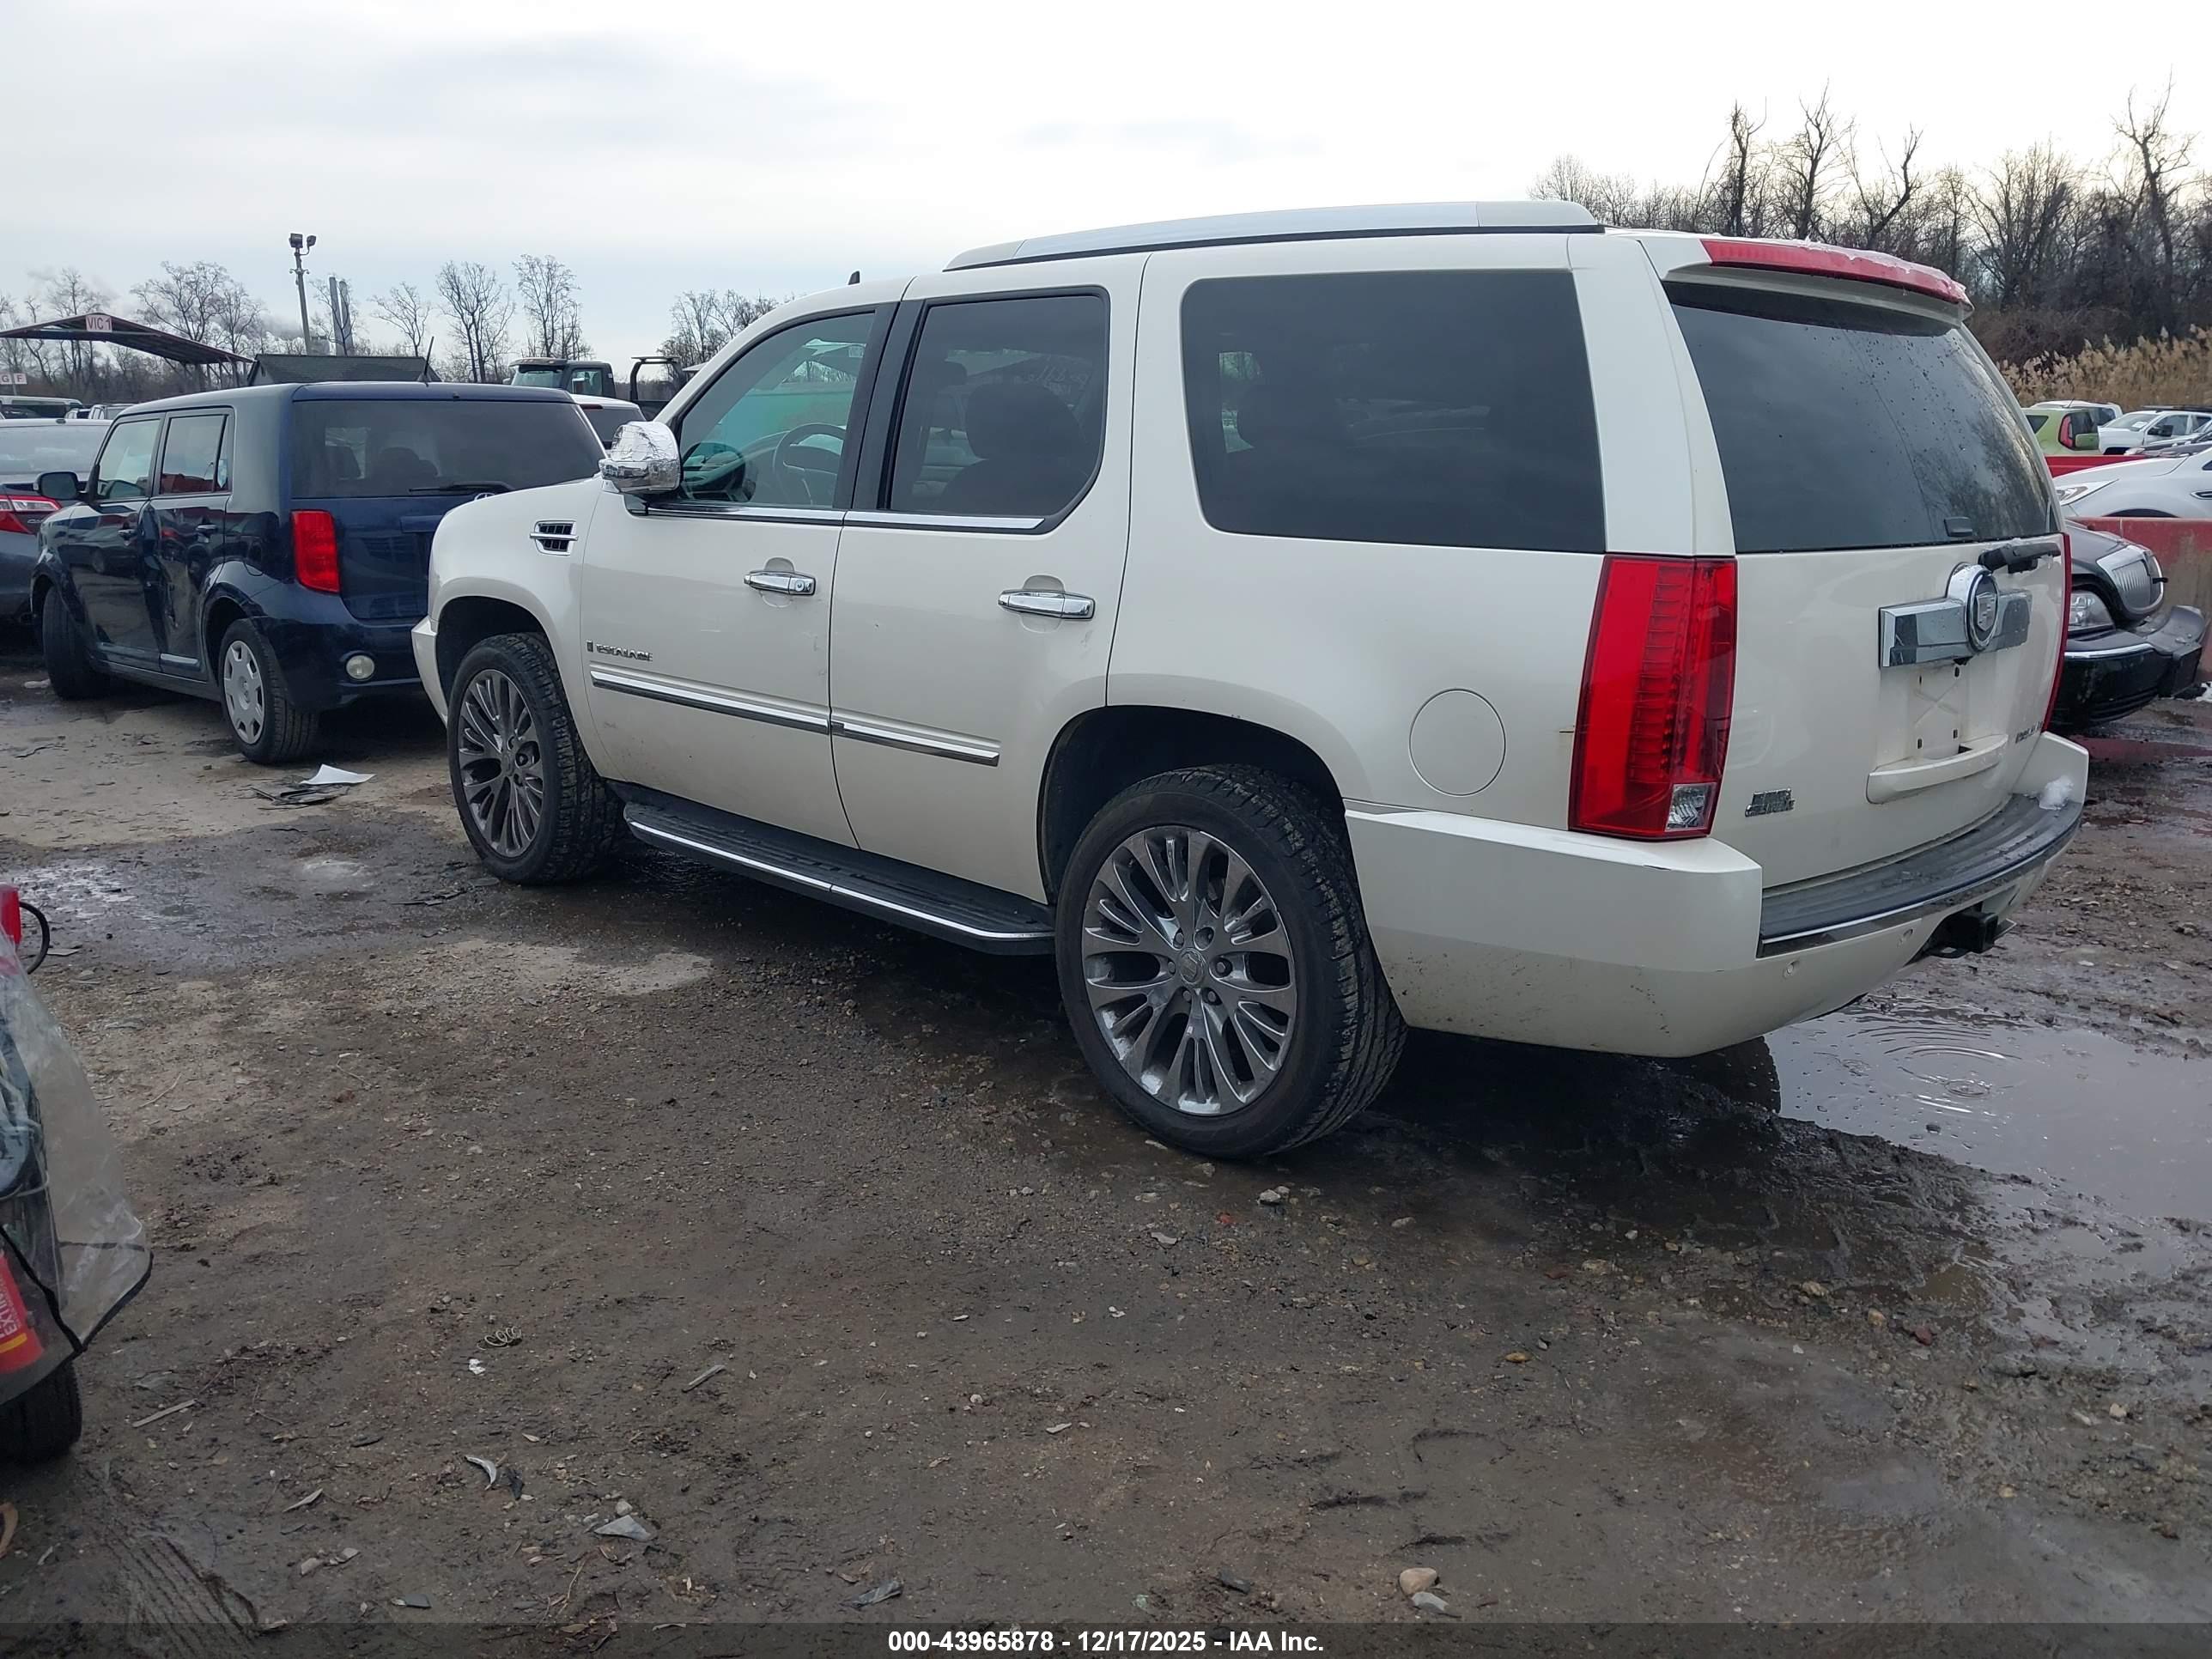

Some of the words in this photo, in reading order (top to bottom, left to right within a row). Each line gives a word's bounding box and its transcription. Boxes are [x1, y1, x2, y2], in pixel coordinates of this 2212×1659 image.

[87, 316, 104, 330] VIC
[105, 317, 112, 331] 1
[16, 374, 23, 383] F
